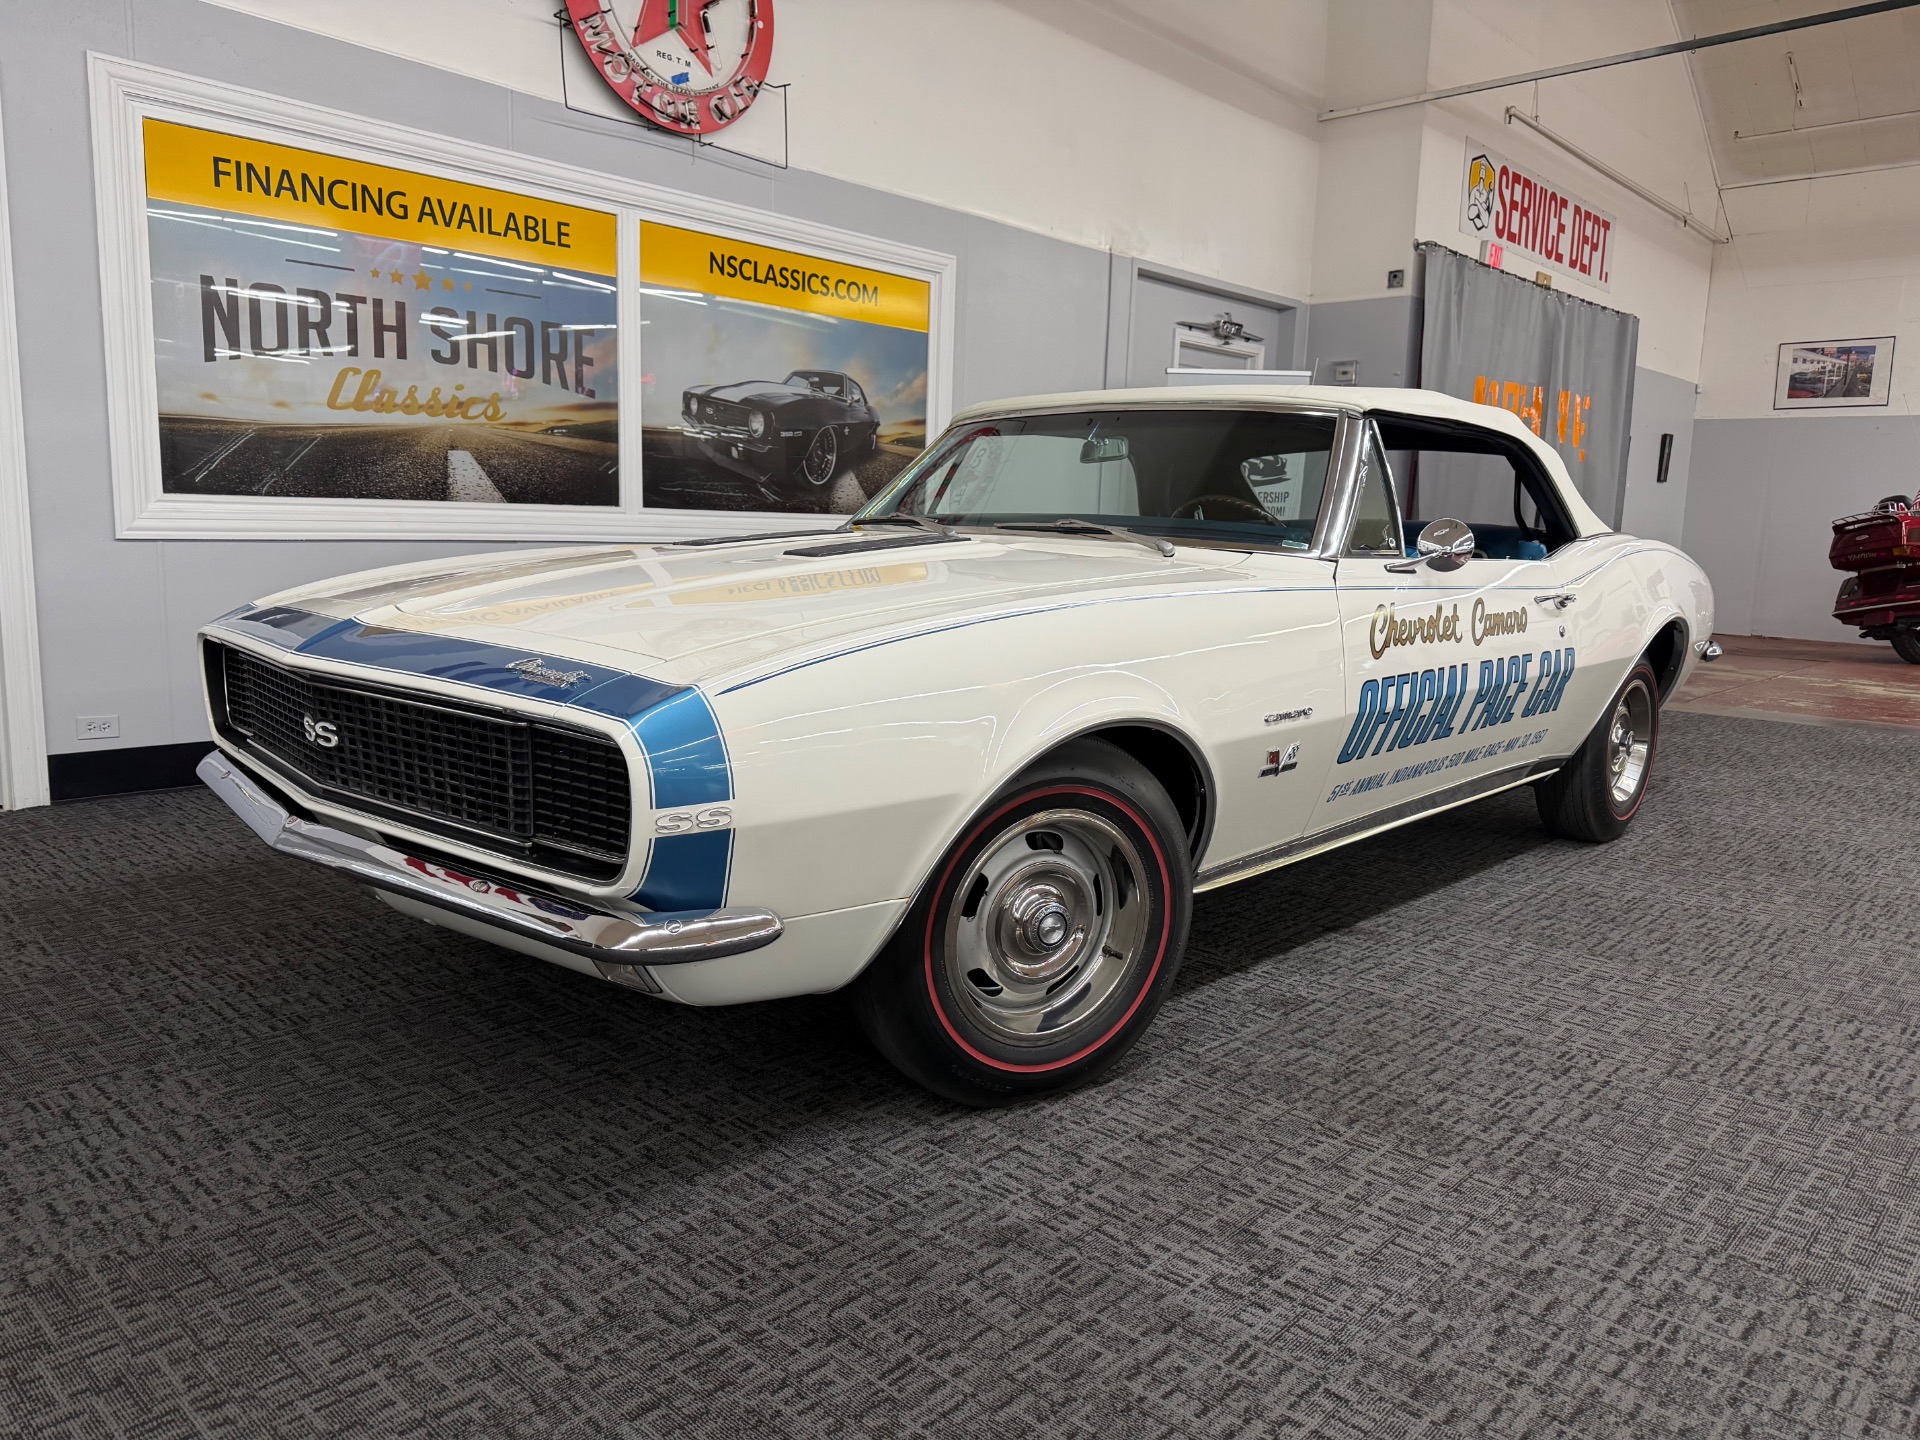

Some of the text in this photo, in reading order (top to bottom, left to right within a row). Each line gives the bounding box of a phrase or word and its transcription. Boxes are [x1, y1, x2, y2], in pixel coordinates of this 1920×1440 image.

[657, 79, 669, 90] THE
[212, 156, 571, 249] FINANCING AVAILABLE
[1495, 165, 1611, 283] SERVICE DEPT.
[709, 251, 879, 307] NSCLASSICS.COM
[200, 274, 596, 399] NORTH SHORE
[327, 367, 507, 421] Classics
[1370, 597, 1528, 660] Chevrolet Camaro
[303, 714, 339, 748] SS
[1337, 647, 1575, 764] OFFICIAL PACE CAR
[1348, 771, 1390, 797] ANNUAL
[1386, 755, 1449, 786] INDIANAPOLIS
[1445, 751, 1466, 769] 500
[1461, 746, 1486, 765] MILE
[655, 806, 733, 834] SS
